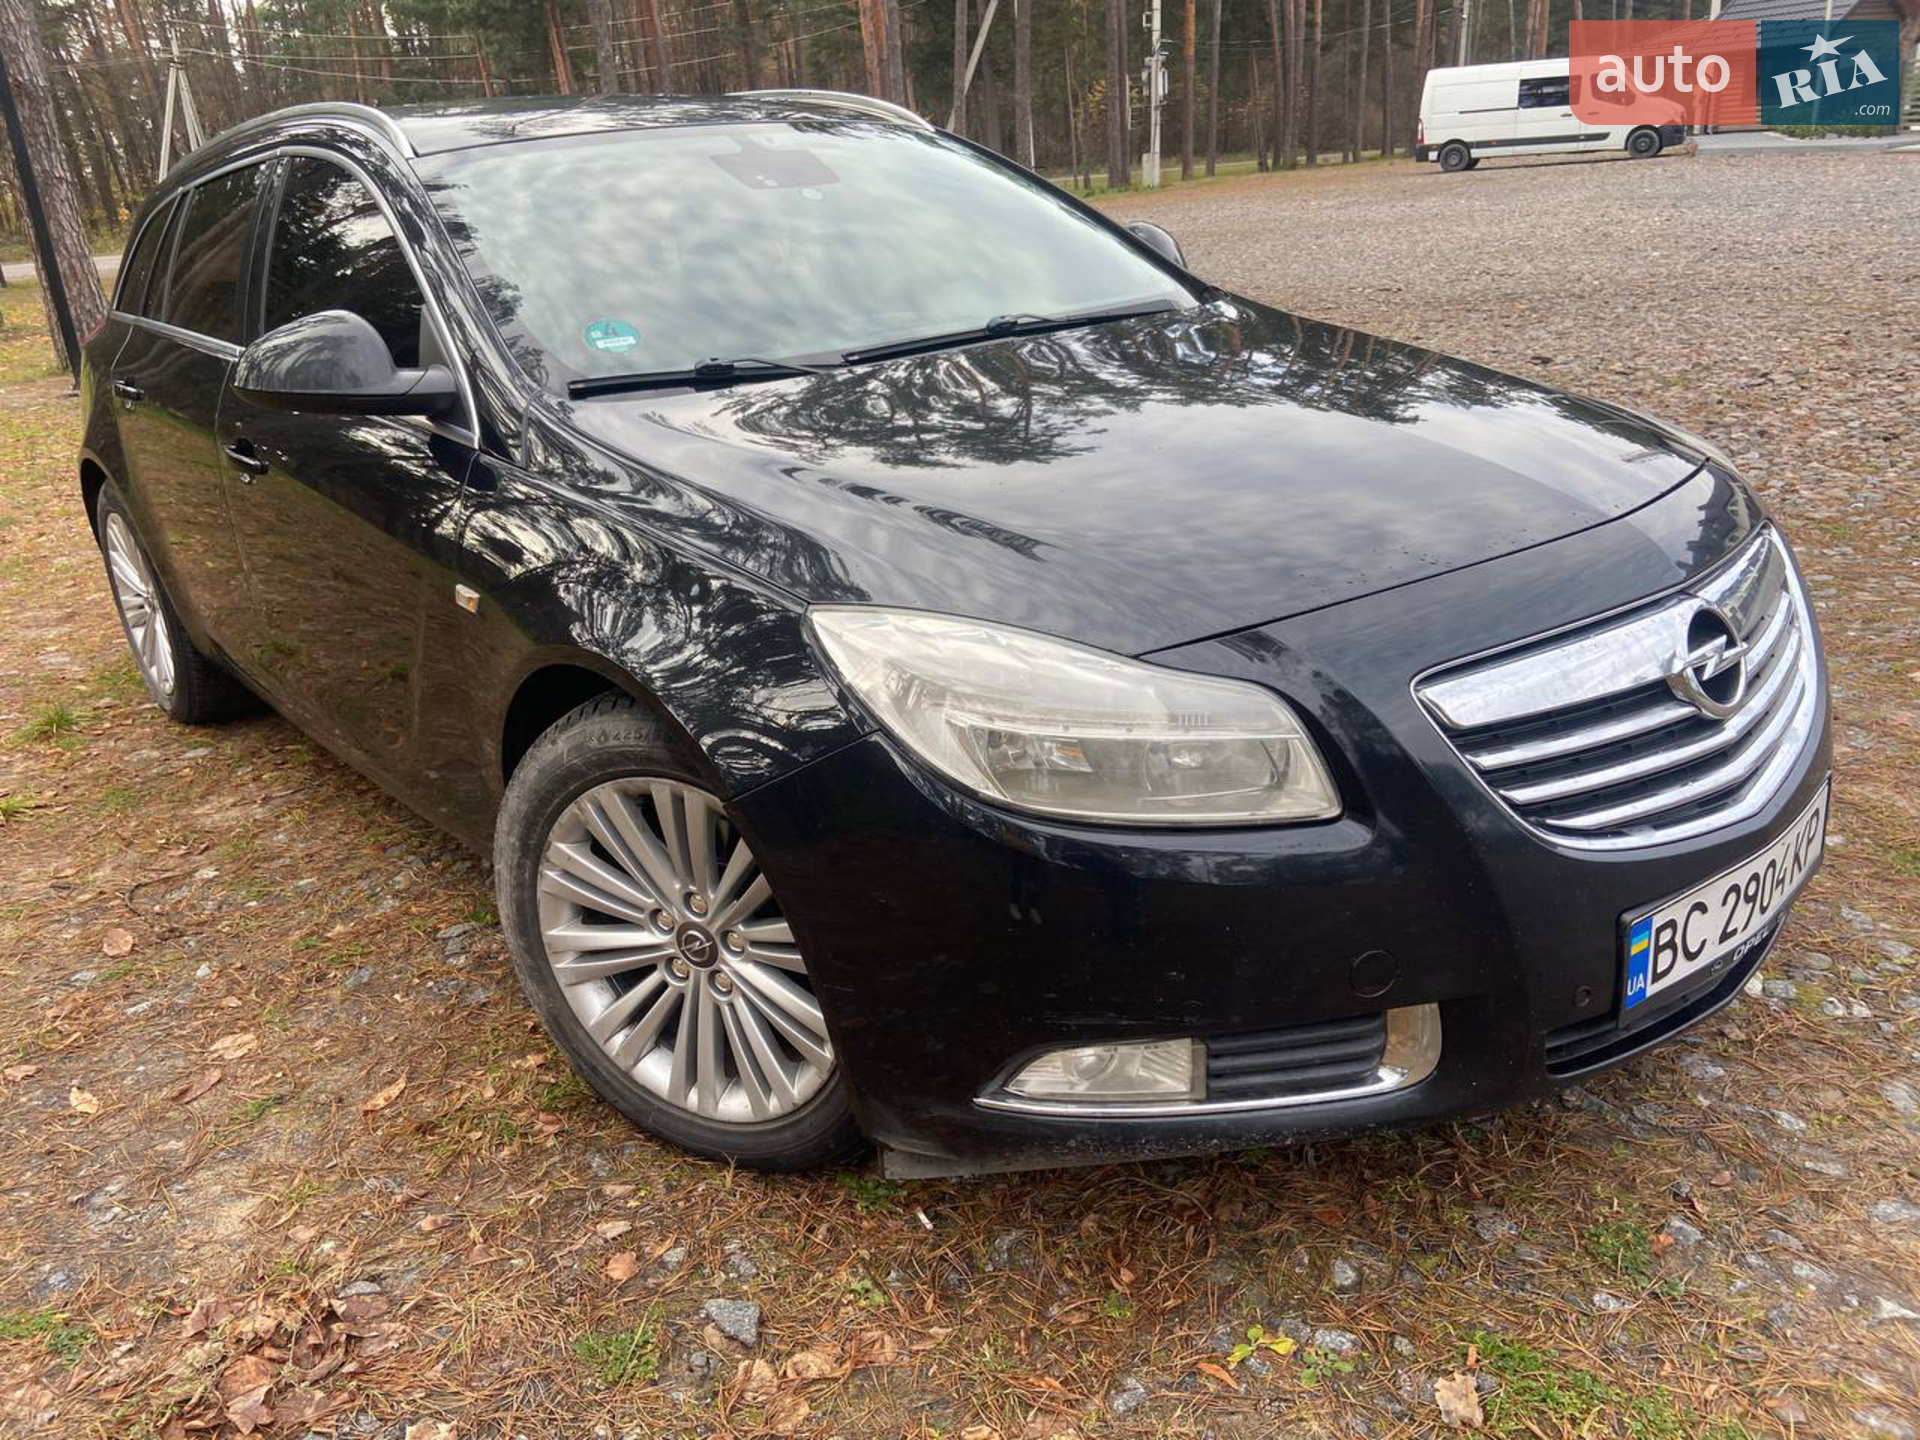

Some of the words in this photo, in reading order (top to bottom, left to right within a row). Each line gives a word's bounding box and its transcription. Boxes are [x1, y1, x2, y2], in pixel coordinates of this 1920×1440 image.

[1651, 901, 1708, 985] BC
[1718, 842, 1791, 945] 2904
[1789, 807, 1820, 884] KP
[1627, 973, 1646, 996] UA
